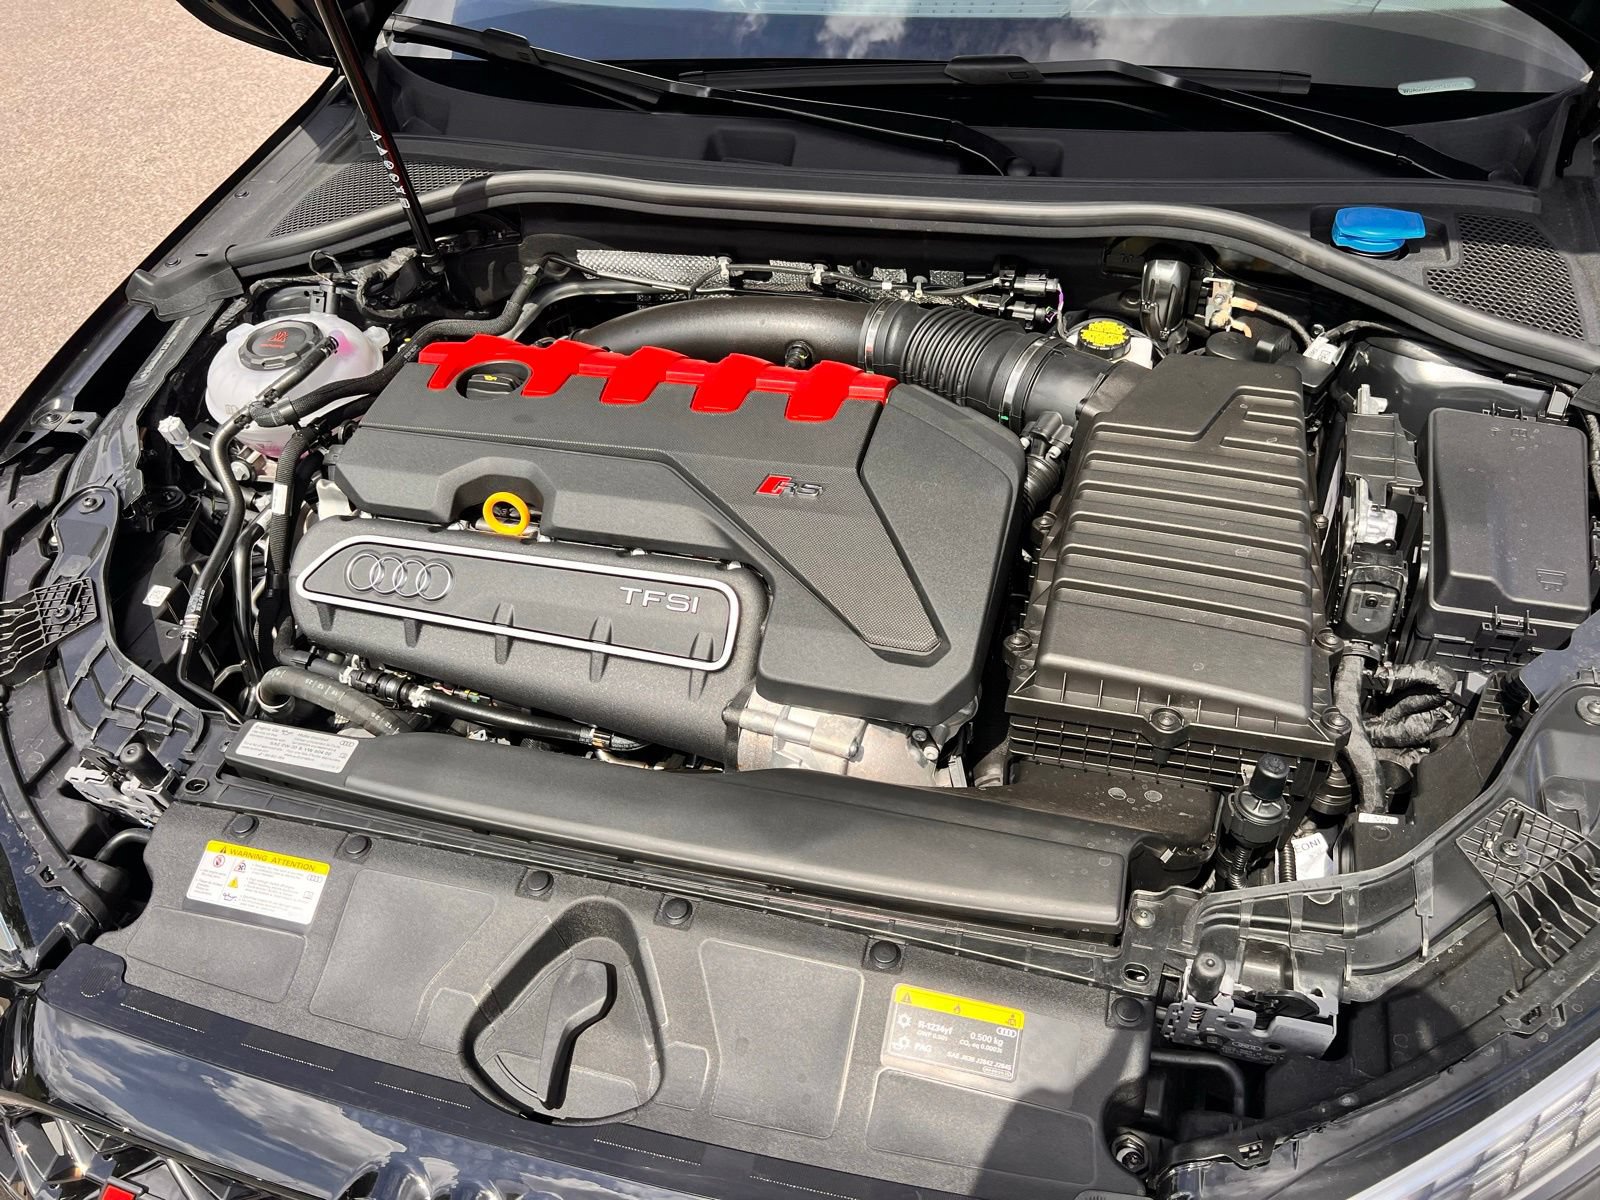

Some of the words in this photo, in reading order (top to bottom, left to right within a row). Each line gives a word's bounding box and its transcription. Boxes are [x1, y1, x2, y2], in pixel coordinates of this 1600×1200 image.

[762, 476, 823, 496] RS
[620, 586, 699, 614] TFSI
[1295, 838, 1322, 854] EONI
[230, 848, 268, 862] WARNING
[270, 856, 316, 872] ATTENTION
[970, 1031, 993, 1044] 0.500
[993, 1037, 1004, 1048] kg
